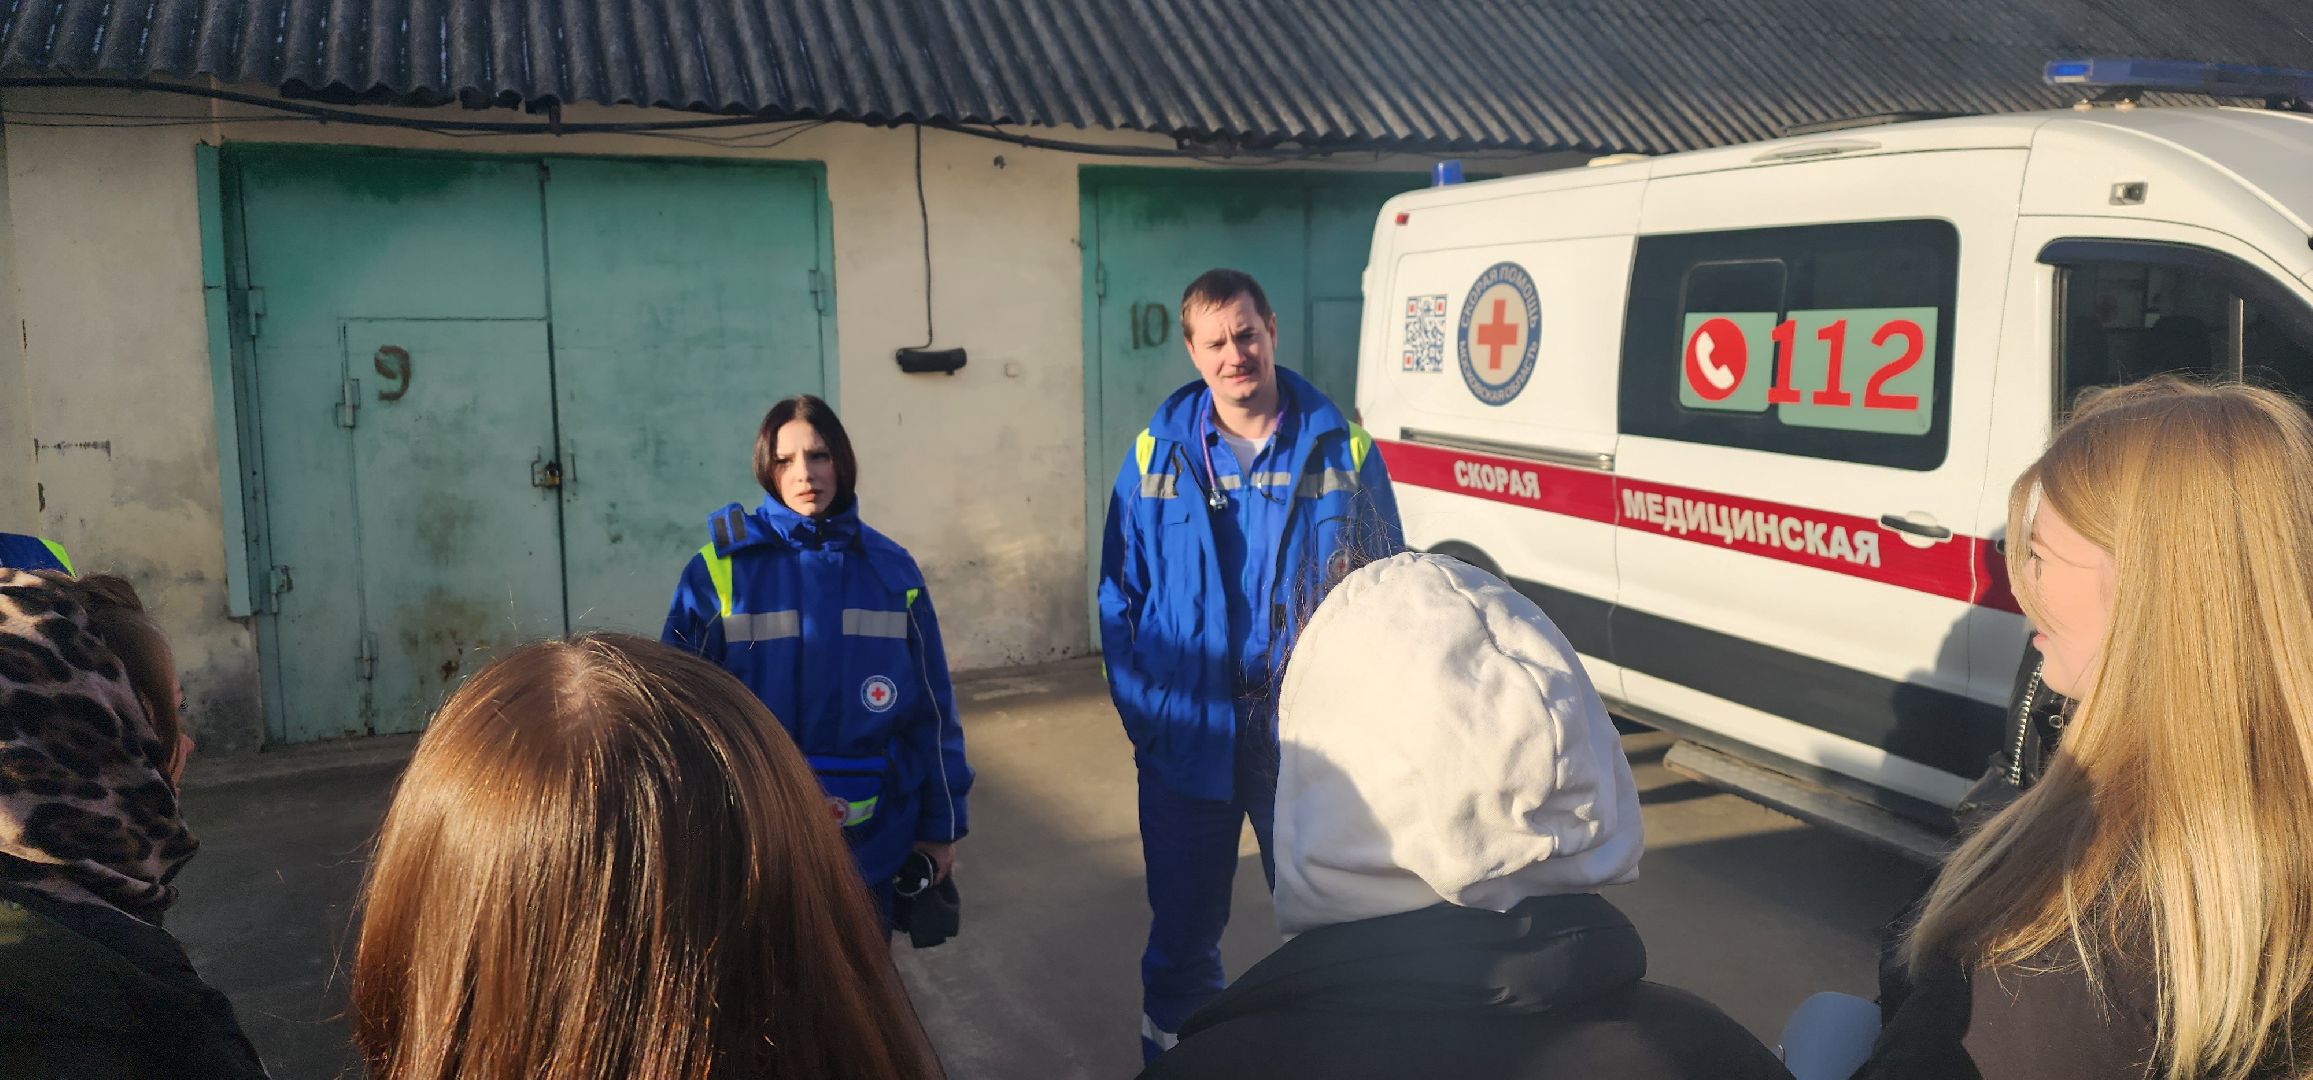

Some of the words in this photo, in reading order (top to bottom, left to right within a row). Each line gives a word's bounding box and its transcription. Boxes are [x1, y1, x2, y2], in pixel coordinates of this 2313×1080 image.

[1131, 302, 1169, 349] 10
[1460, 268, 1498, 328] СКОРАЯ
[1500, 266, 1540, 329] ПОМОЩЬ
[373, 344, 411, 401] 9
[1767, 319, 1925, 411] 112
[1453, 460, 1542, 500] СКОРАЯ
[1621, 488, 1882, 568] МЕДИЦИНСКАЯ
